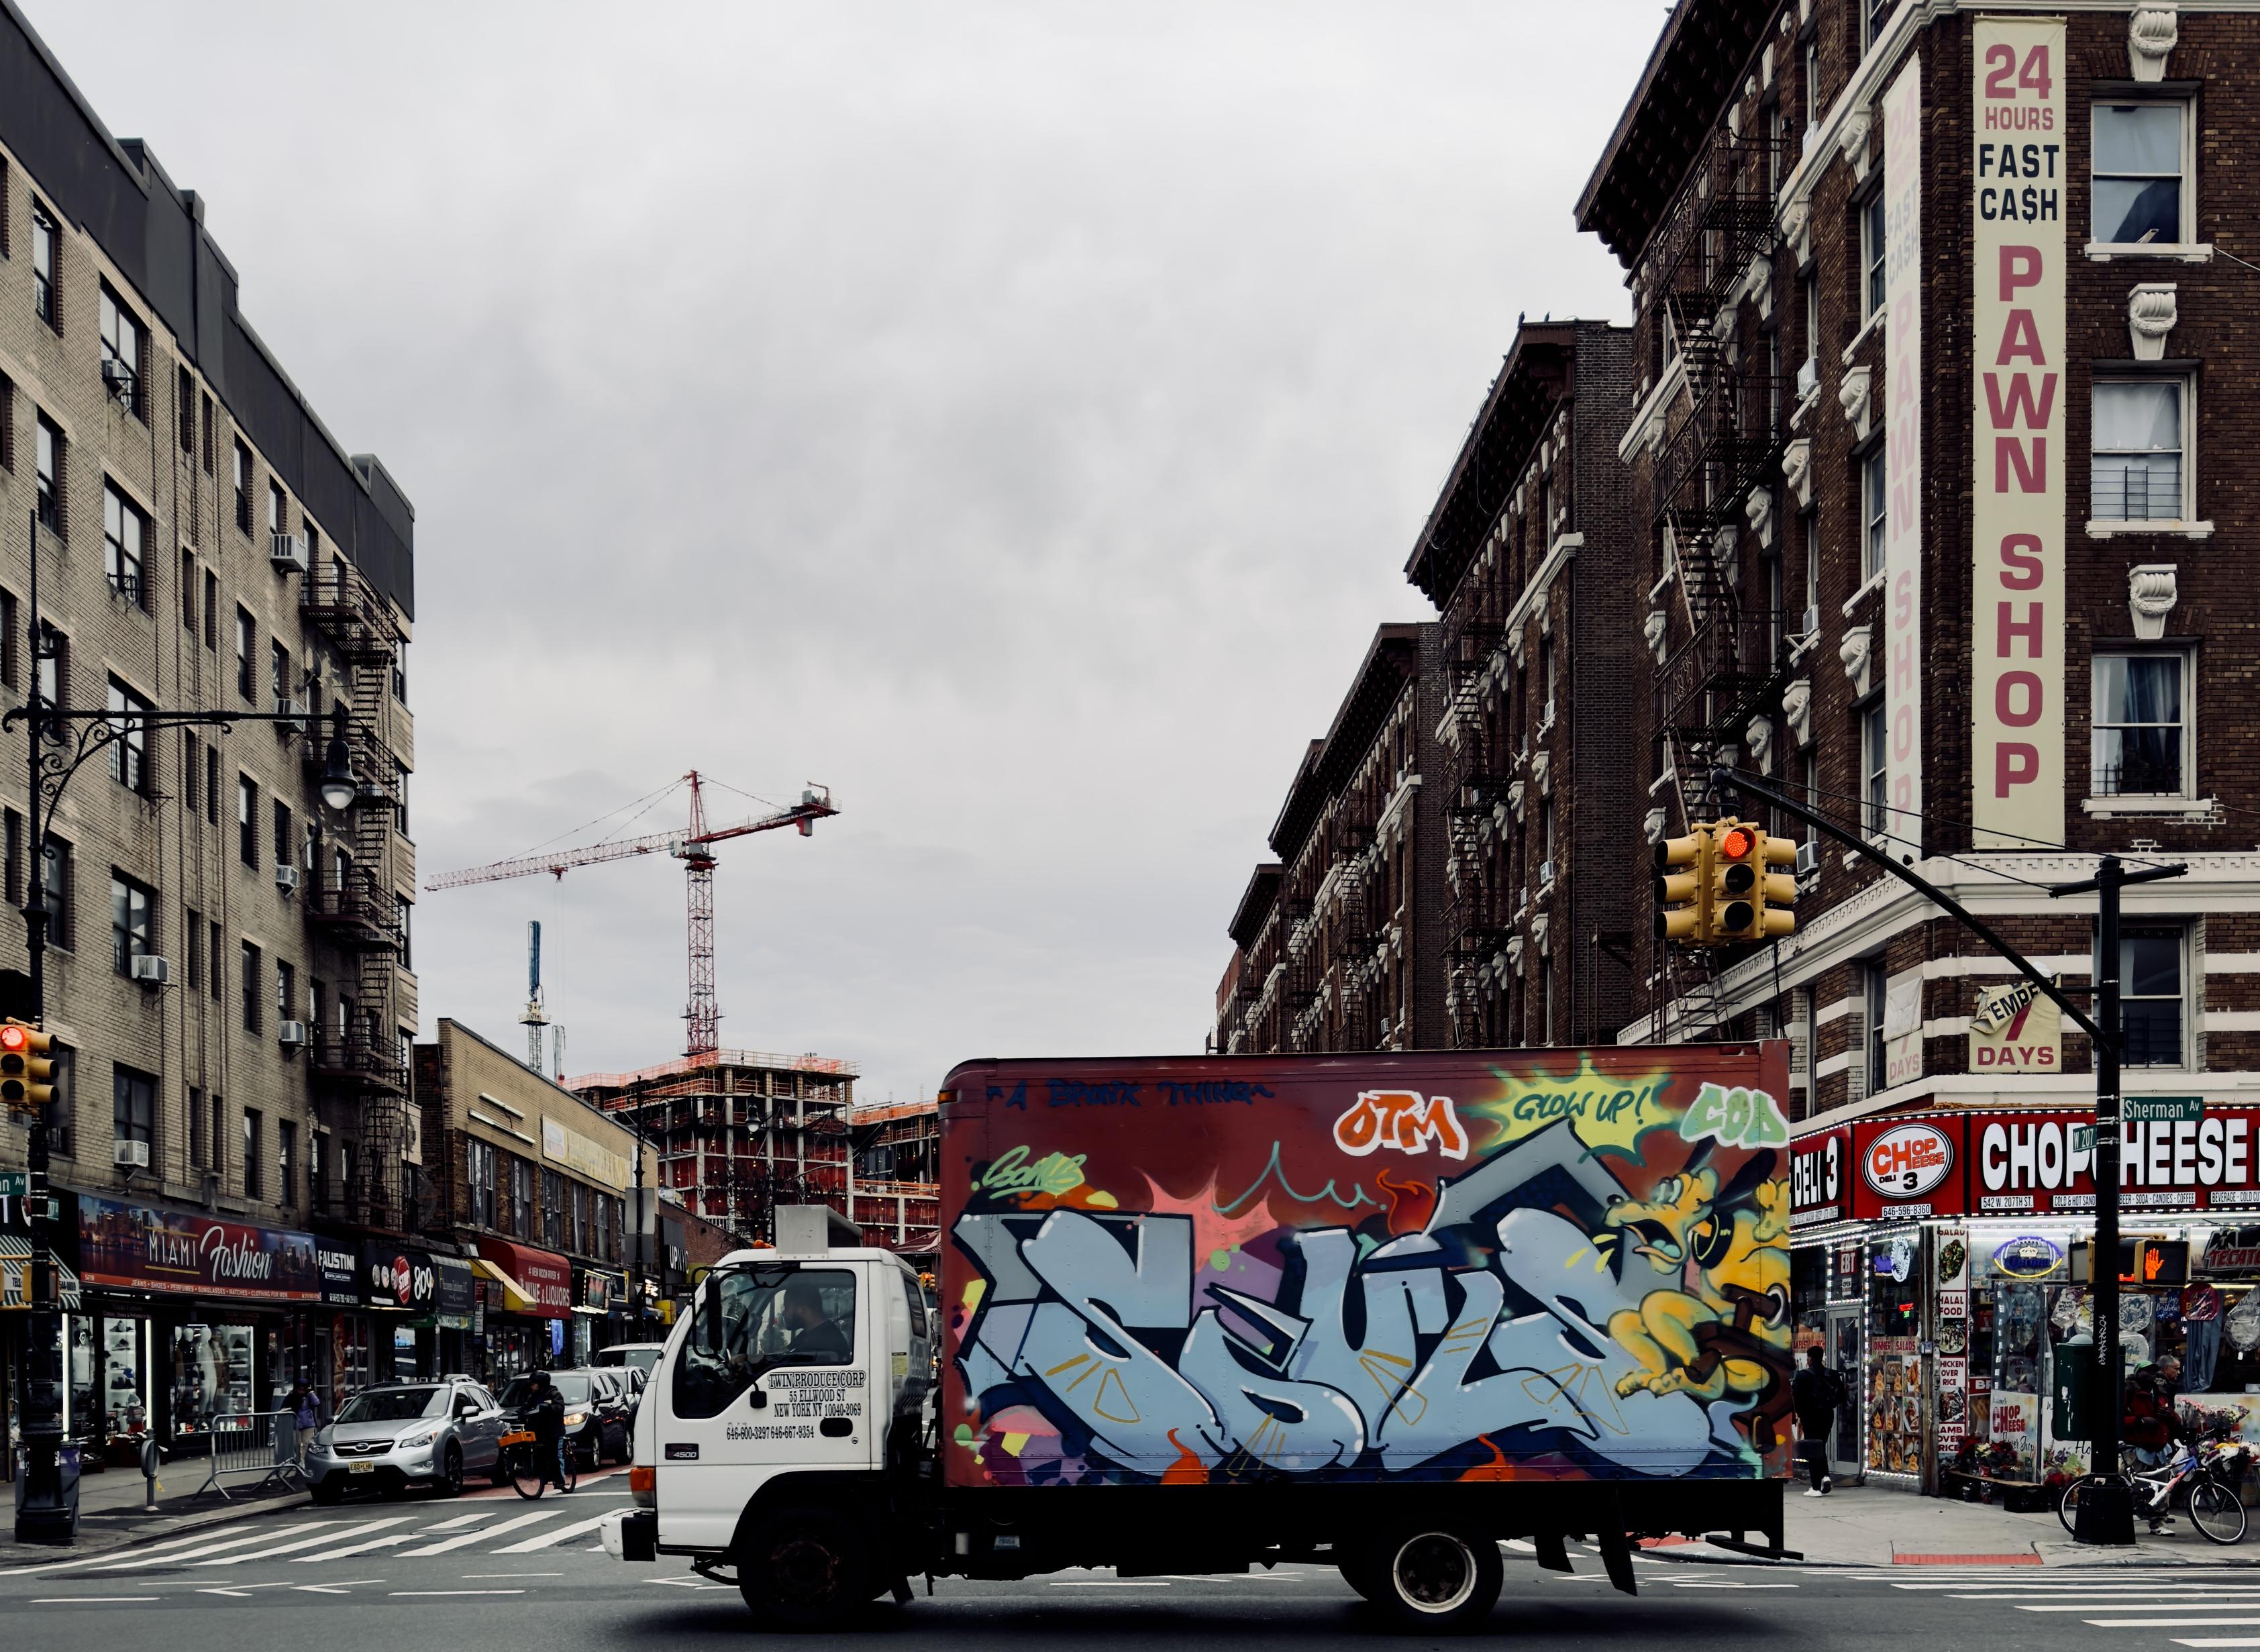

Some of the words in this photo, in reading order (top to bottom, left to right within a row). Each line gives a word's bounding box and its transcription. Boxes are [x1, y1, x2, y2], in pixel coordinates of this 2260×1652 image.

[1985, 44, 2053, 100] 24
[1985, 107, 2053, 131] HOURS
[1979, 144, 2059, 178] FAST
[1983, 245, 2058, 493] PAWN
[1995, 533, 2044, 798] SHOP
[1978, 1046, 2055, 1066] DAYS
[1889, 1053, 1920, 1081] DAYS
[1514, 1090, 1594, 1121] GLOW
[1595, 1086, 1645, 1125] UP!
[2124, 1099, 2184, 1119] Sherman
[2189, 1100, 2200, 1112] Av
[2073, 1131, 2079, 1149] W
[2082, 1129, 2094, 1147] 207
[1982, 1121, 2091, 1191] CHOP
[2092, 1117, 2247, 1186] HEESE
[15, 1176, 25, 1186] Av
[1794, 1149, 1821, 1207] DELI
[1826, 1136, 1838, 1200] 3
[1879, 1174, 1896, 1184] DELI
[1902, 1172, 1918, 1190] 3
[1983, 1198, 1995, 1208] 542
[2004, 1197, 2022, 1207] 207TH
[2024, 1196, 2033, 1206] ST.
[2055, 1196, 2066, 1206] COLD
[2067, 1196, 2071, 1206] &
[2072, 1196, 2082, 1206] HOT
[2120, 1195, 2131, 1205] BEER
[2136, 1194, 2148, 1204] SODA
[2153, 1194, 2173, 1204] CANDIES
[2177, 1193, 2194, 1203] COFFEE
[2212, 1192, 2237, 1202] BEVERAGE
[2240, 1192, 2252, 1201] COLD
[1883, 1204, 1931, 1217] 646-596-8360
[149, 1232, 196, 1267] MIAMI
[199, 1225, 273, 1283] Fashion
[318, 1250, 355, 1272] FAUSTINI
[1841, 1252, 1855, 1274] EBT
[413, 1266, 432, 1300] 809
[525, 1281, 540, 1304] WINE
[546, 1285, 570, 1307] LIQUORS
[1939, 1296, 1964, 1305] HALAL
[1873, 1341, 1891, 1351] DINNER
[1896, 1341, 1916, 1351] SALADS
[1939, 1360, 1964, 1369] HICKEN
[1941, 1368, 1959, 1377] OVER
[768, 1374, 792, 1388] TWIN
[794, 1373, 838, 1388] PRODUCE
[839, 1372, 865, 1387] CORP
[1943, 1378, 1957, 1386] RICE
[789, 1391, 797, 1402] 55
[799, 1390, 835, 1402] ELLWOOD
[837, 1389, 845, 1401] ST
[774, 1403, 790, 1417] NEW
[792, 1403, 811, 1417] YORK
[813, 1403, 823, 1416] NY
[825, 1403, 862, 1416] 10040-2069
[727, 1427, 770, 1440] 646-600-3297
[770, 1425, 814, 1439] 646-667-9354
